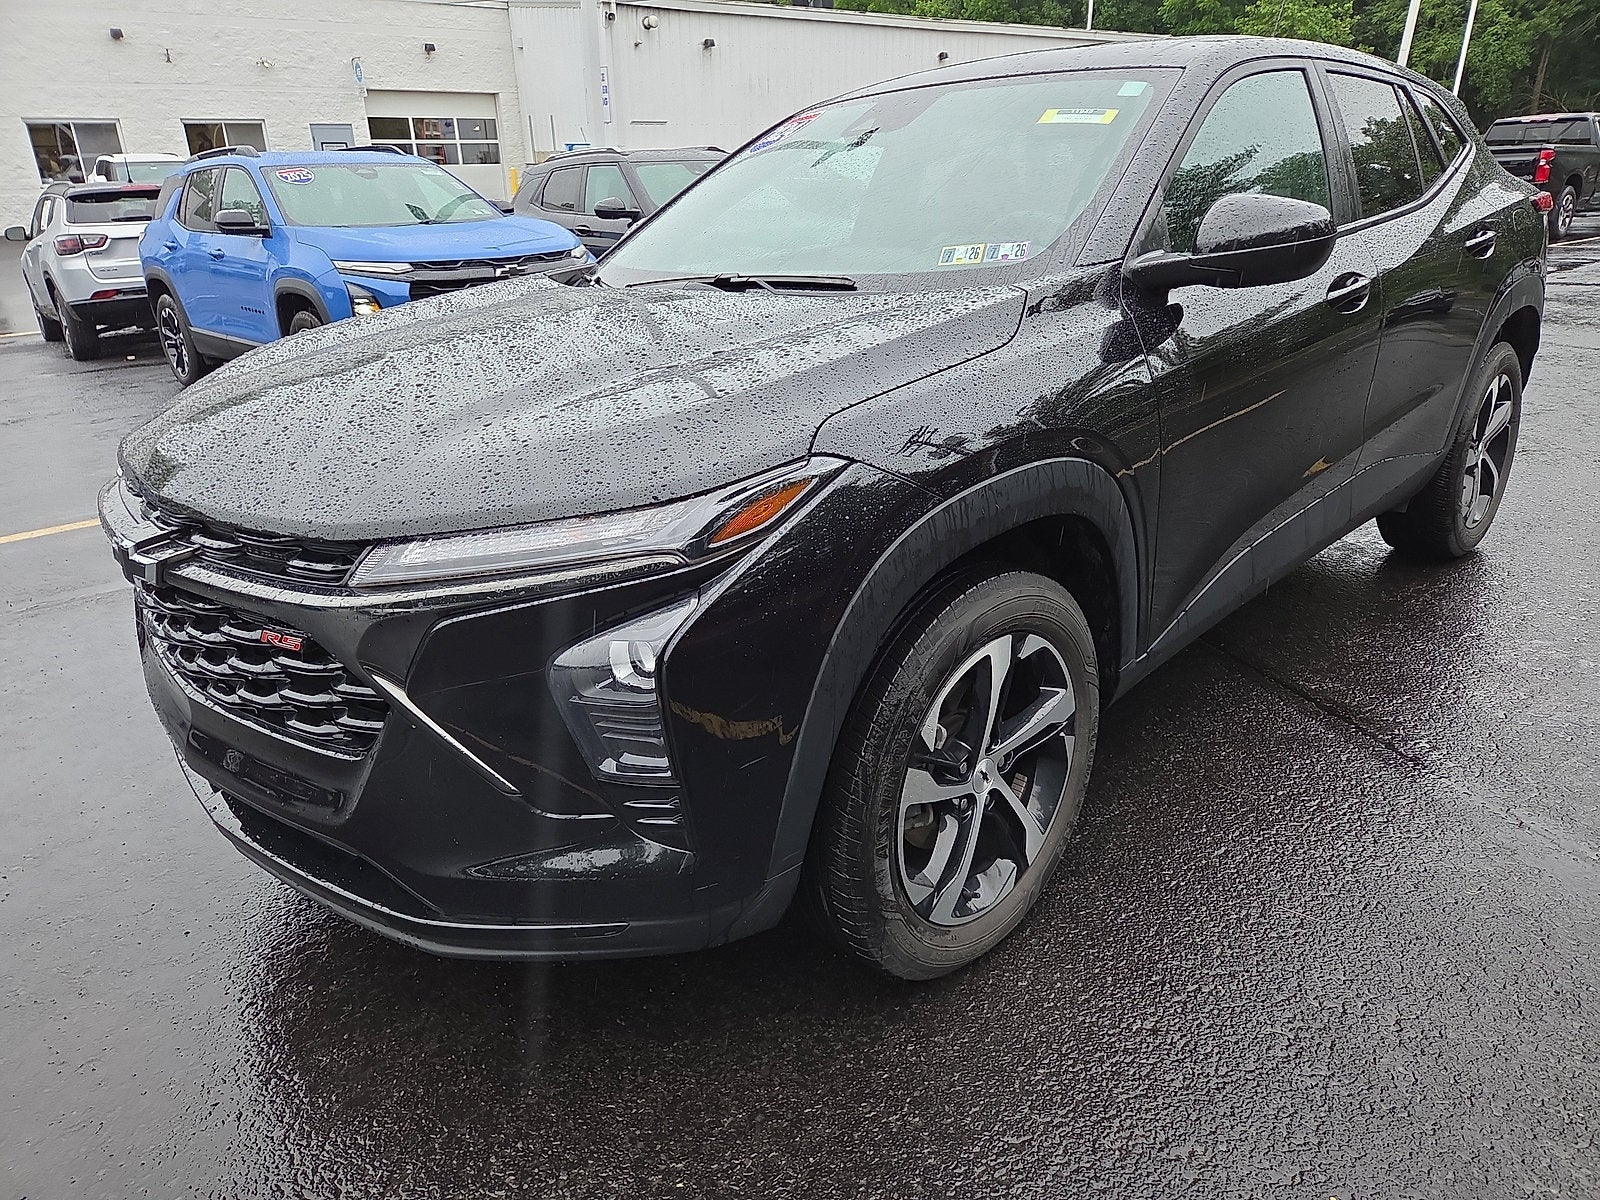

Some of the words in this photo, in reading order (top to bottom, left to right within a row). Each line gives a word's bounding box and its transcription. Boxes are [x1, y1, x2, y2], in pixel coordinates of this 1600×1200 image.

[283, 170, 313, 182] 2025
[968, 246, 981, 260] 26
[1014, 243, 1027, 257] 26
[261, 630, 302, 651] RS
